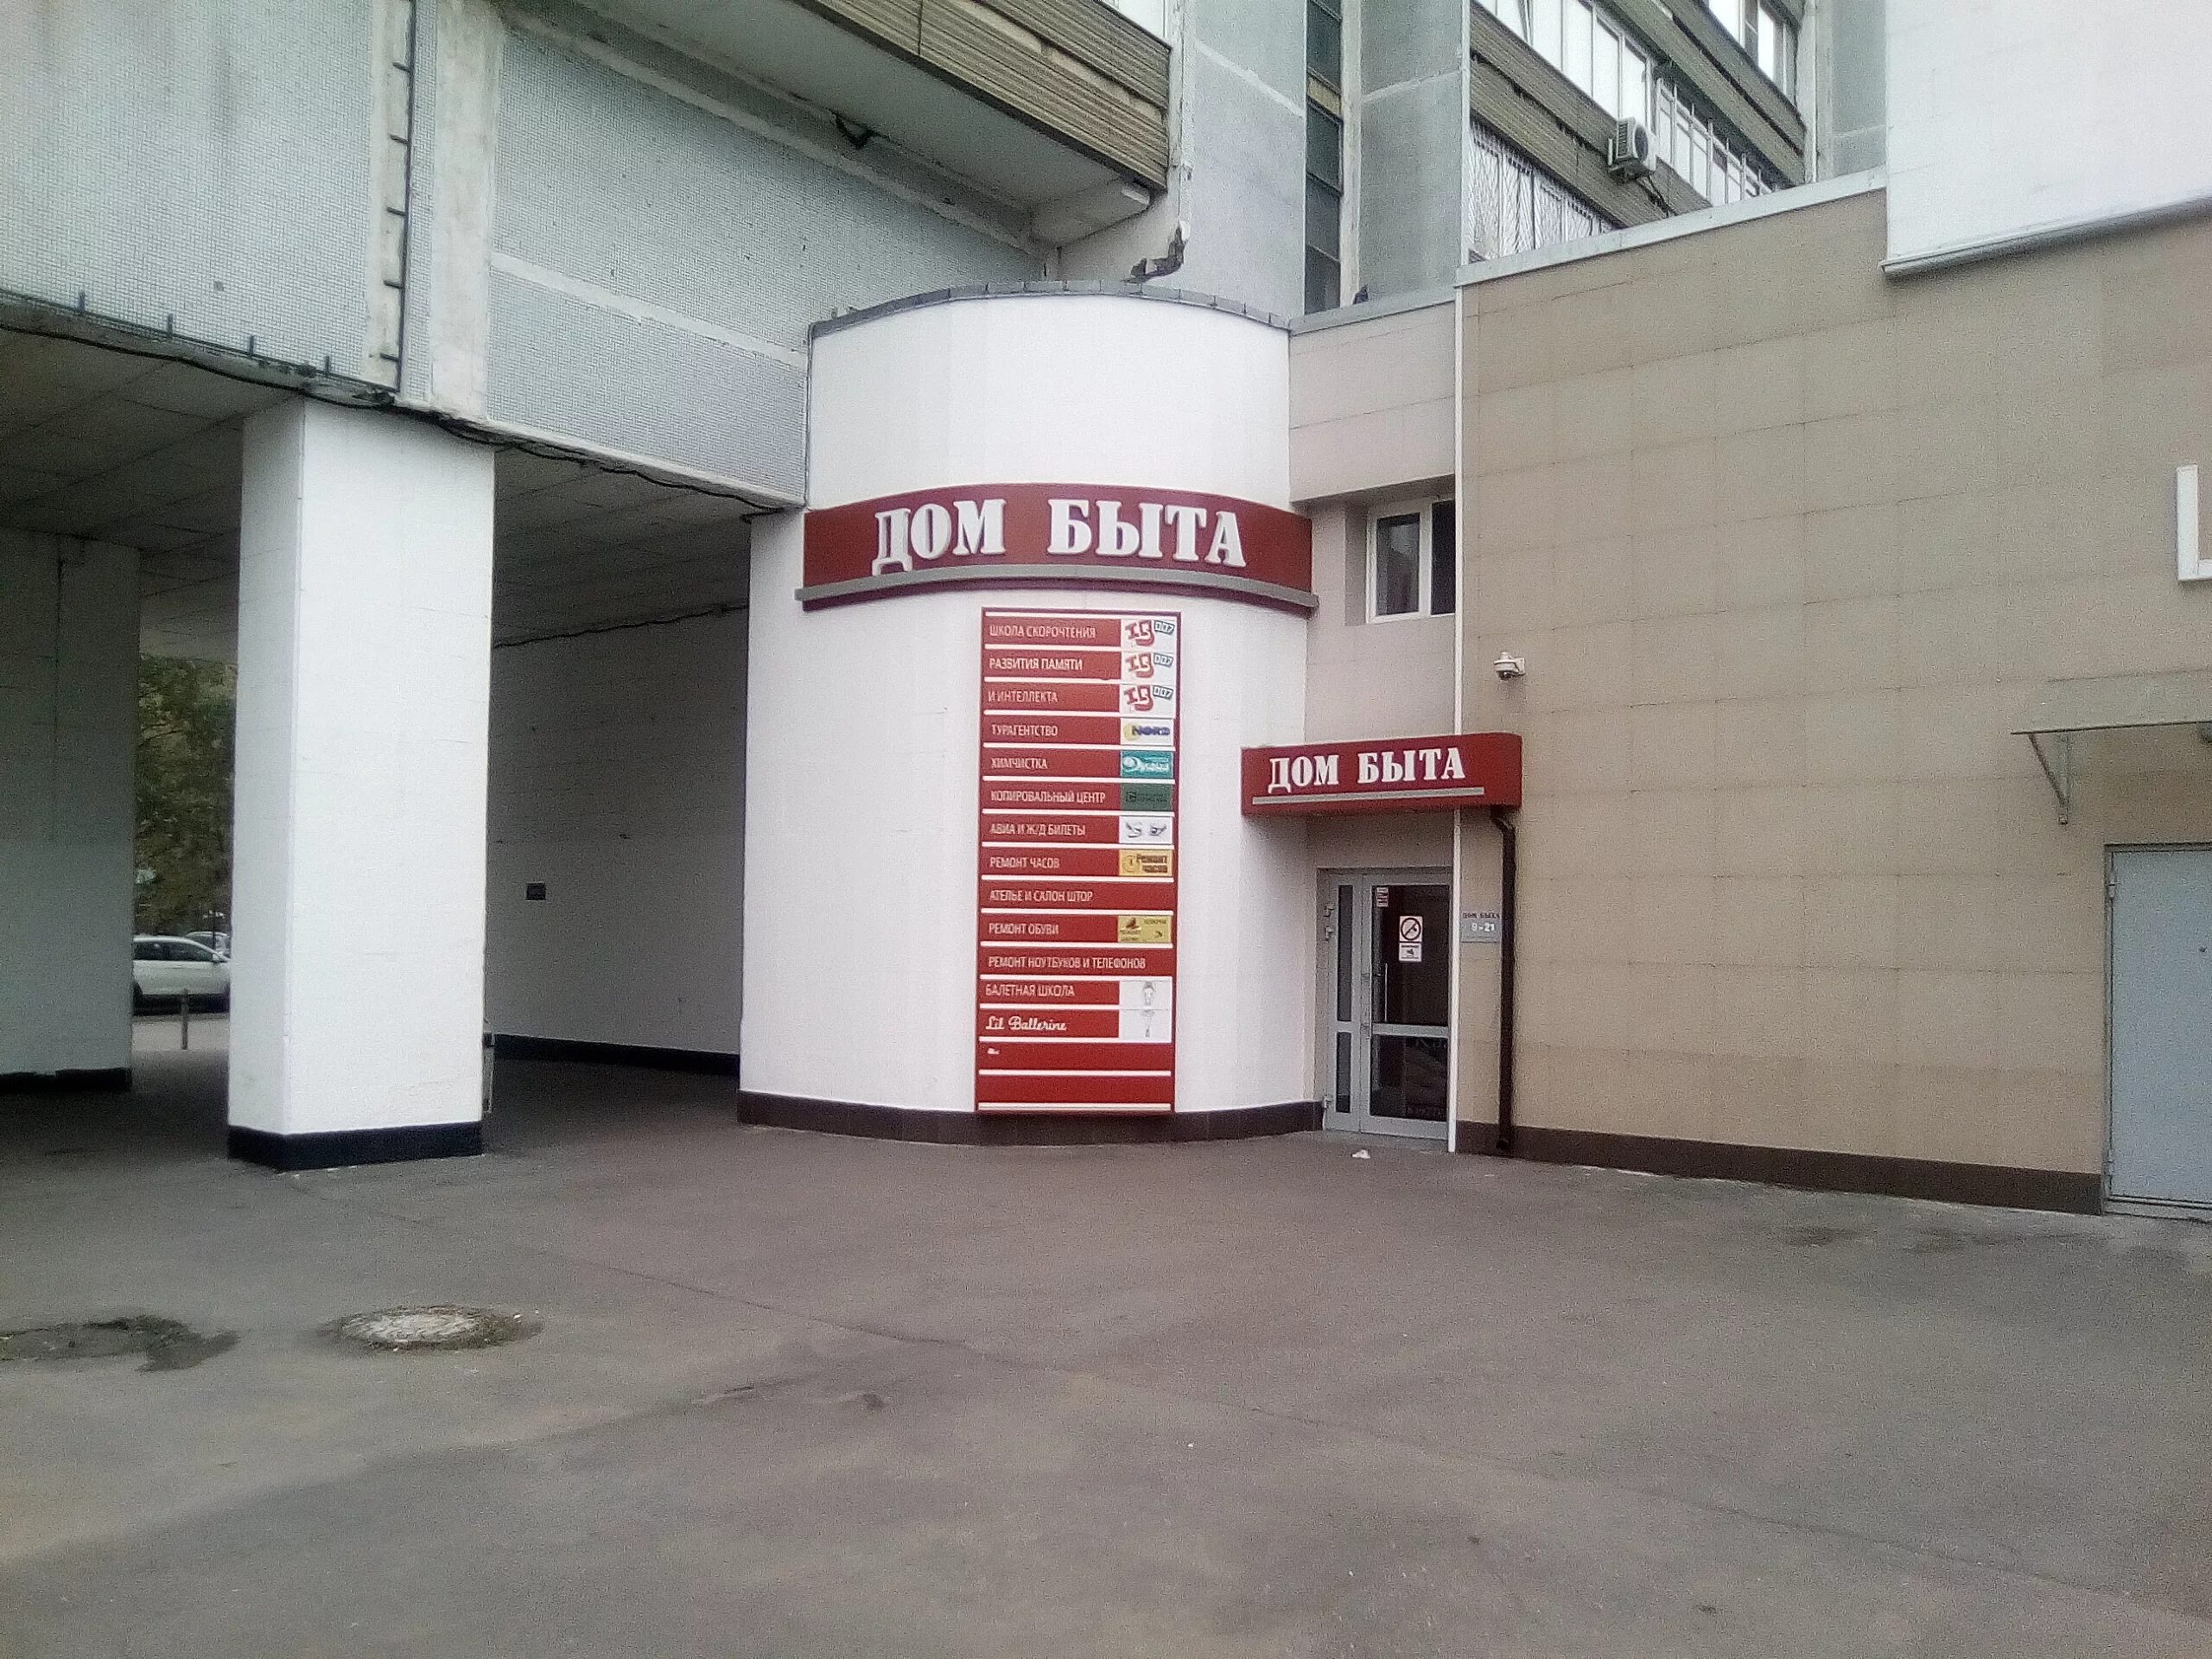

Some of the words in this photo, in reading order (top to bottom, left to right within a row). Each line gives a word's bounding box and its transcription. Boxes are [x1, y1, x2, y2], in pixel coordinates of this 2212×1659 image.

[872, 499, 1006, 576] ДОМ
[1046, 499, 1246, 568] БЫТА
[989, 625, 1025, 637] ШКОЛА
[1026, 626, 1096, 639] СКОРОЧТЕНИЯ
[989, 658, 1039, 670] РАЗВИТИЯ
[1041, 658, 1084, 671] ПАМЯТИ
[988, 690, 995, 702] И
[997, 690, 1058, 703] ИНТЕЛЛЕКТА
[991, 724, 1058, 736] ТУРАГЕНТСТВО
[991, 757, 1048, 770] ХИМЧИСТКА
[1268, 754, 1339, 794] ДОМ
[1357, 747, 1465, 784] БЫТА
[990, 790, 1075, 803] КОПИРОВАЛЬНЫЙ
[1076, 791, 1106, 804] ЦЕНТР
[990, 823, 1016, 835] АВИА
[1017, 823, 1026, 835] И
[1027, 823, 1046, 836] Ж/Д
[1047, 823, 1086, 836] БИЛЕТЫ
[989, 856, 1027, 868] РЕМОНТ
[1029, 857, 1060, 869] ЧАСОВ
[989, 890, 1023, 902] АТЕЛЬЕ
[1024, 890, 1032, 901] И
[1033, 890, 1065, 902] САЛОН
[1066, 891, 1093, 902] ШТОР
[988, 923, 1026, 934] РЕМОНТ
[1027, 923, 1059, 935] ОБУВИ
[988, 956, 1026, 968] РЕМОНТ
[1027, 957, 1081, 969] НОУТБУКОВ
[1082, 957, 1090, 969] И
[1092, 957, 1147, 969] ТЕЛЕФОНОВ
[985, 983, 1036, 996] БАЛЕТНАЯ
[1037, 984, 1075, 997] ШКОЛА
[985, 1015, 1005, 1030] Lil
[1007, 1015, 1067, 1031] Ballerine
